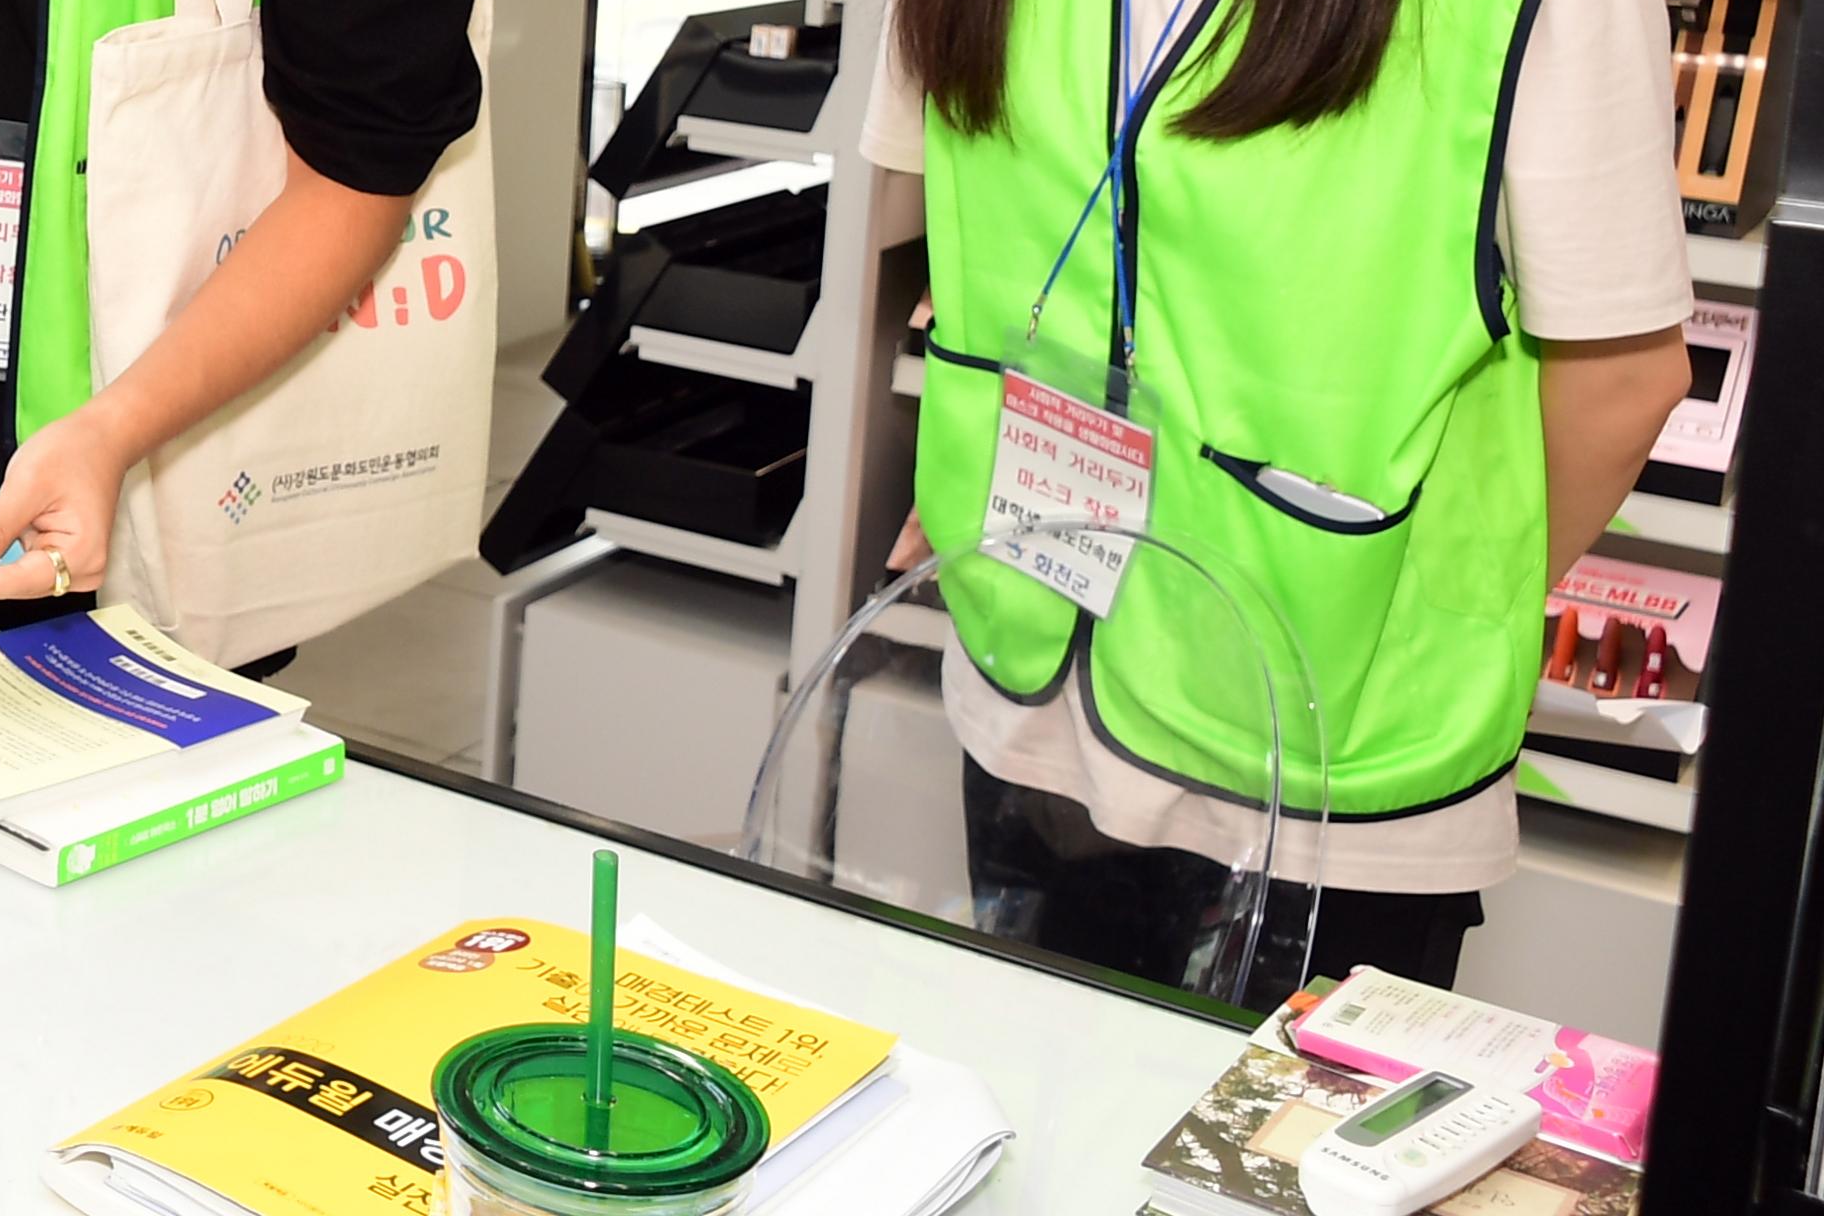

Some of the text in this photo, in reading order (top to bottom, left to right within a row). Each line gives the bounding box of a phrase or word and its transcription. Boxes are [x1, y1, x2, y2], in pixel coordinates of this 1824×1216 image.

[1684, 200, 1730, 223] INGA
[1002, 423, 1145, 499] 사회적 거리두기
[1017, 467, 1072, 506] 마스크
[1033, 552, 1090, 598] 화천군
[613, 995, 709, 1041] 가까운
[709, 1032, 813, 1077] 문제로
[614, 971, 830, 1060] 매경테스트 1위,
[226, 1051, 375, 1118] 에듀윌
[1320, 1146, 1390, 1182] SAMSUNG
